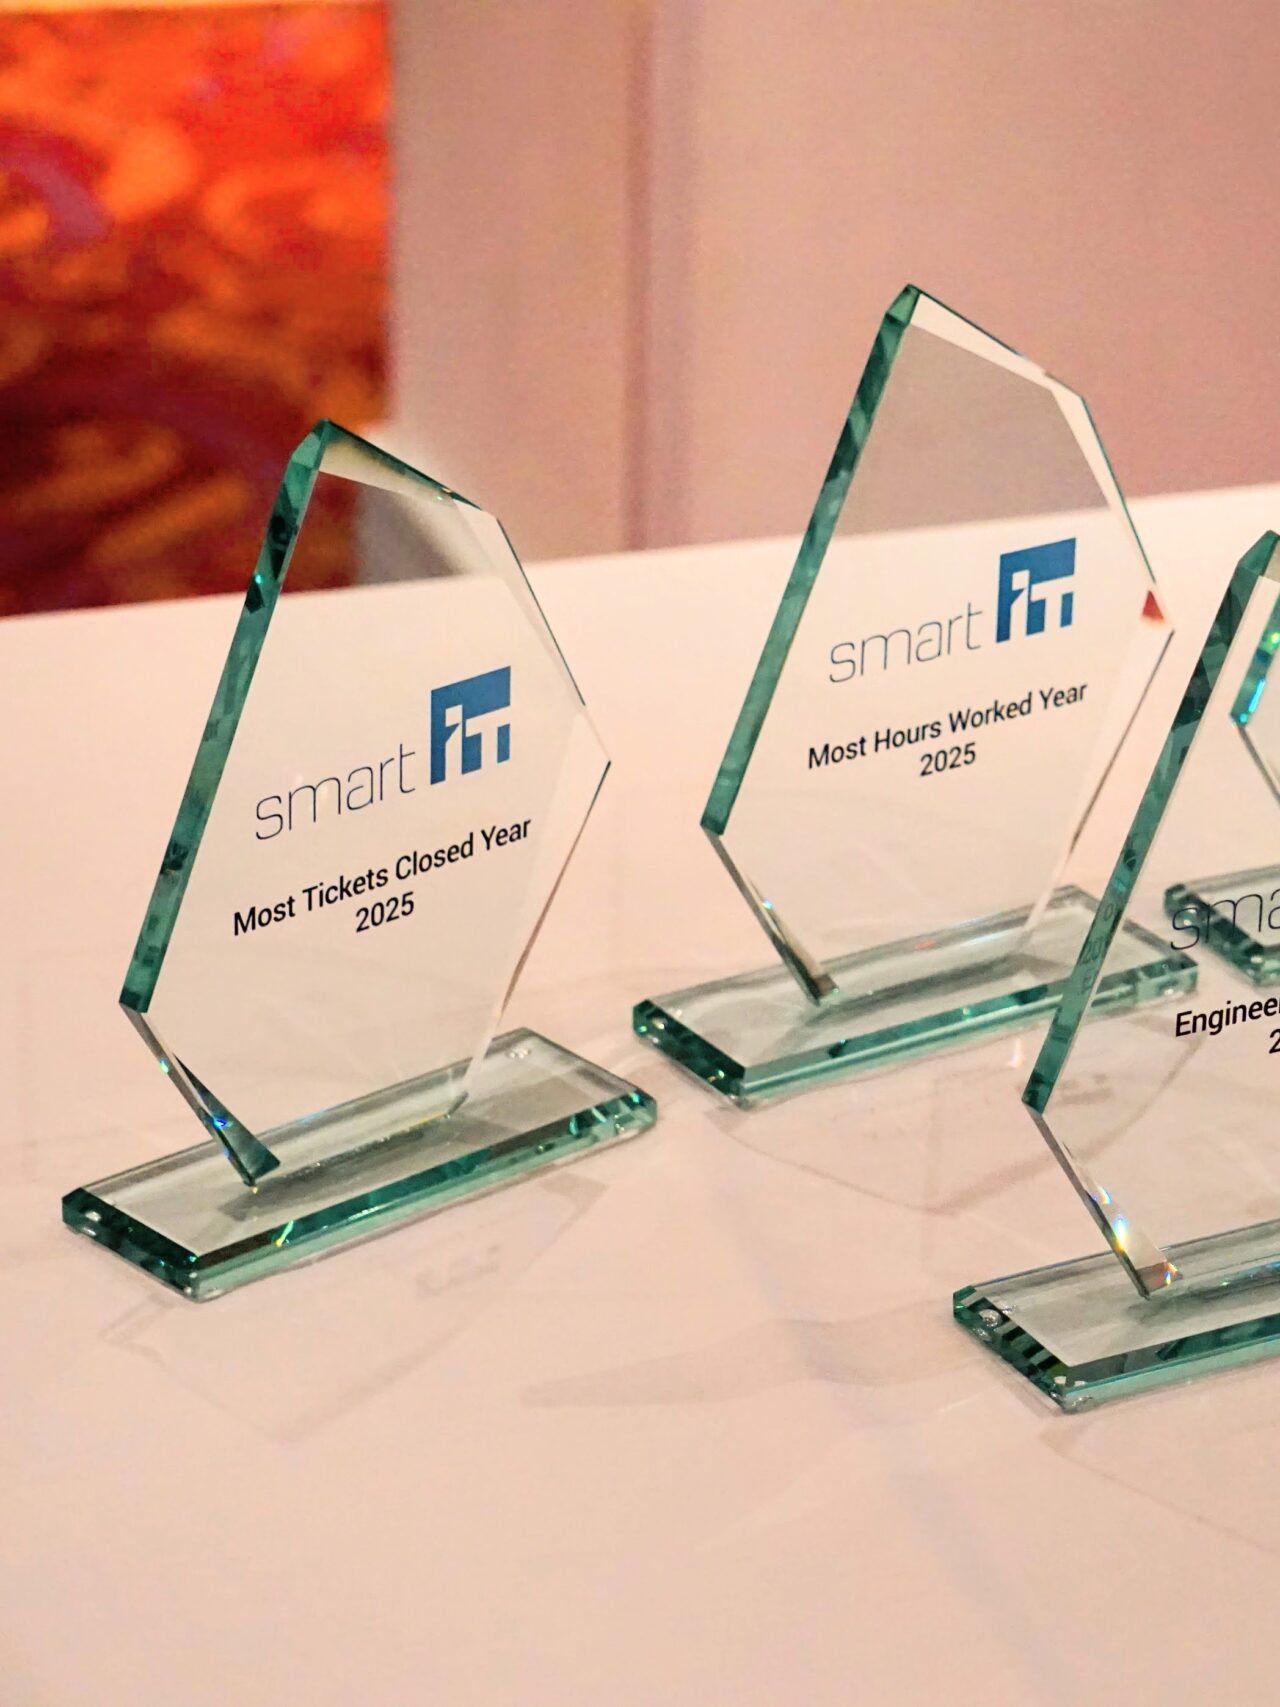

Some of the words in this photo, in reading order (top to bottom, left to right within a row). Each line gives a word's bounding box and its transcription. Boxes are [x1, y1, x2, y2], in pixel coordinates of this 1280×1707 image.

[830, 602, 983, 683] smart
[808, 736, 866, 770] Most
[874, 720, 942, 754] Hours
[949, 692, 1032, 734] Worked
[1040, 684, 1088, 710] Year
[920, 742, 977, 777] 2025
[255, 743, 416, 840] smart
[233, 896, 296, 936] Most
[302, 868, 389, 912] Tickets
[395, 832, 474, 881] Closed
[481, 819, 532, 851] Year
[355, 891, 415, 933] 2025
